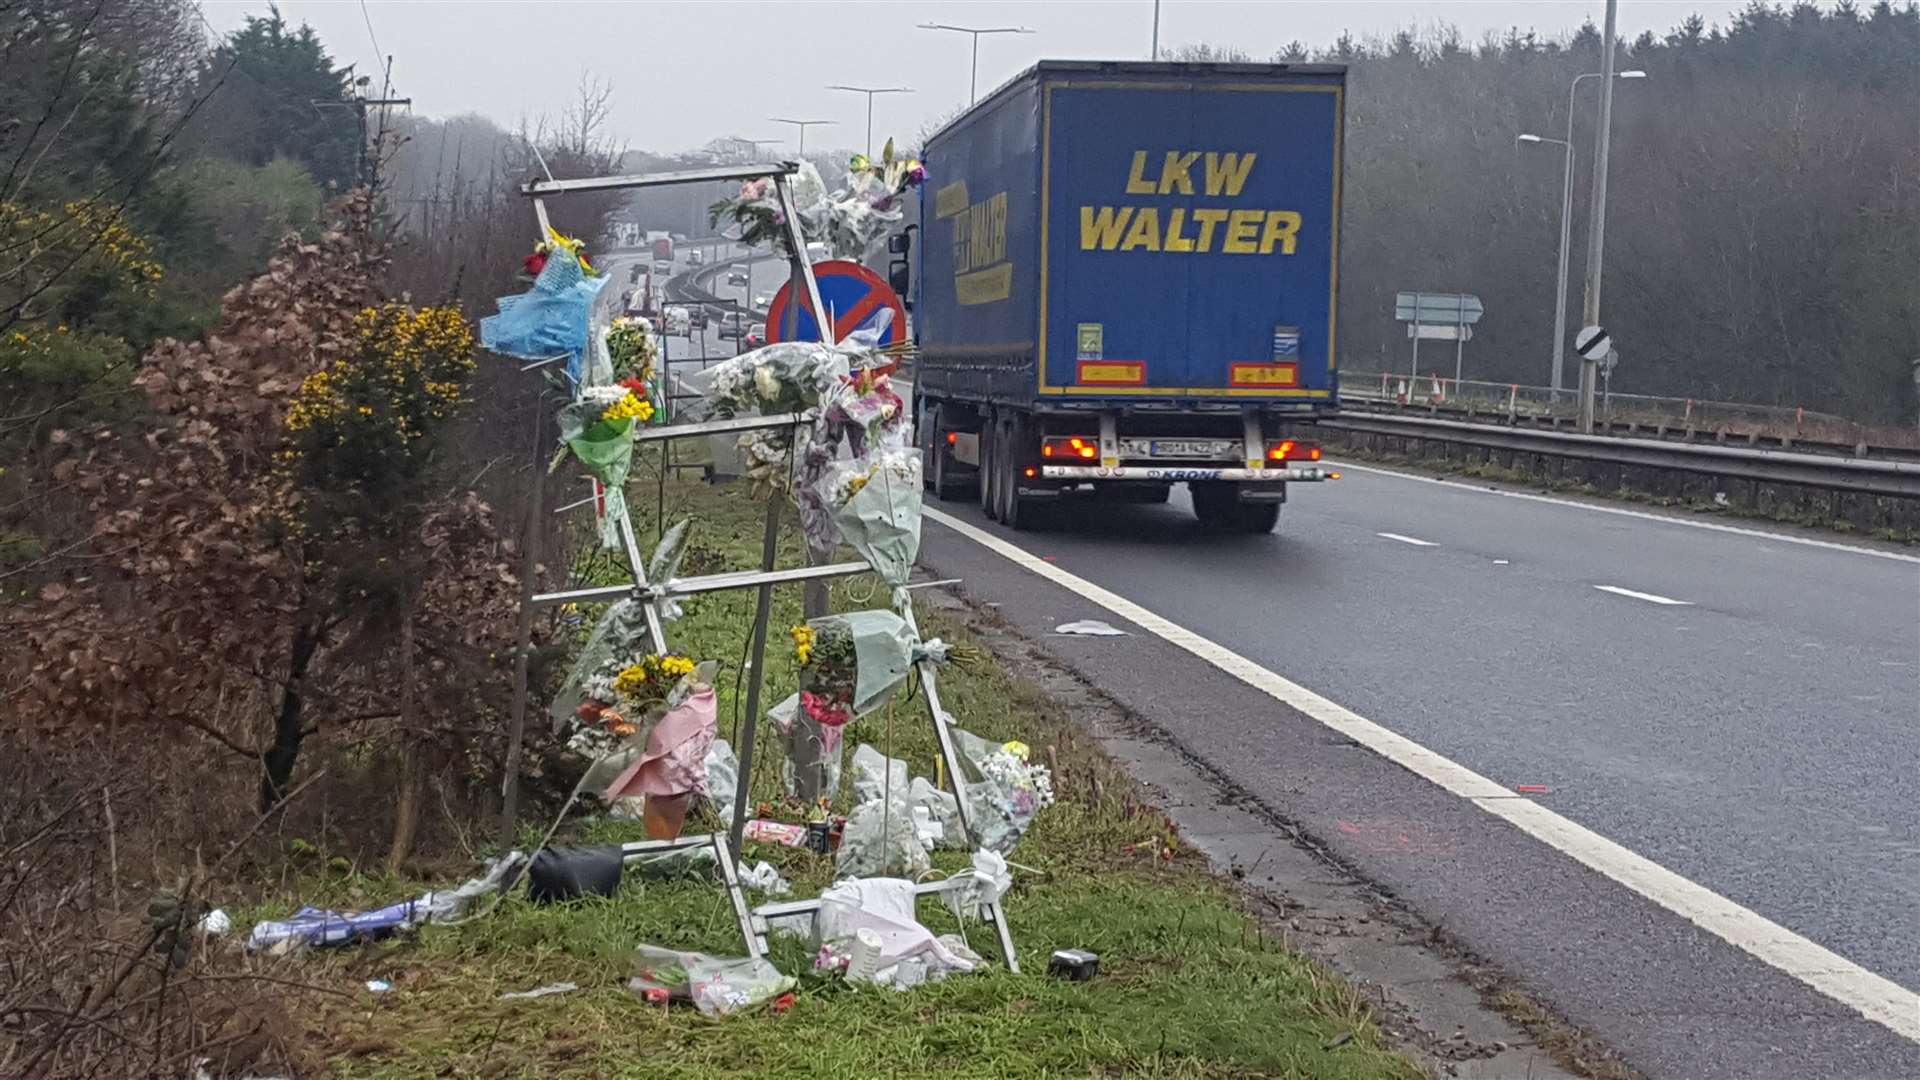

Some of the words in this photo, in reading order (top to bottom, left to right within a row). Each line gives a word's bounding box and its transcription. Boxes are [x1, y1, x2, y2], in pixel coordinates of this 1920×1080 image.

[1126, 150, 1257, 196] LKW
[1080, 205, 1303, 255] WALTER
[1161, 470, 1222, 479] KRONE
